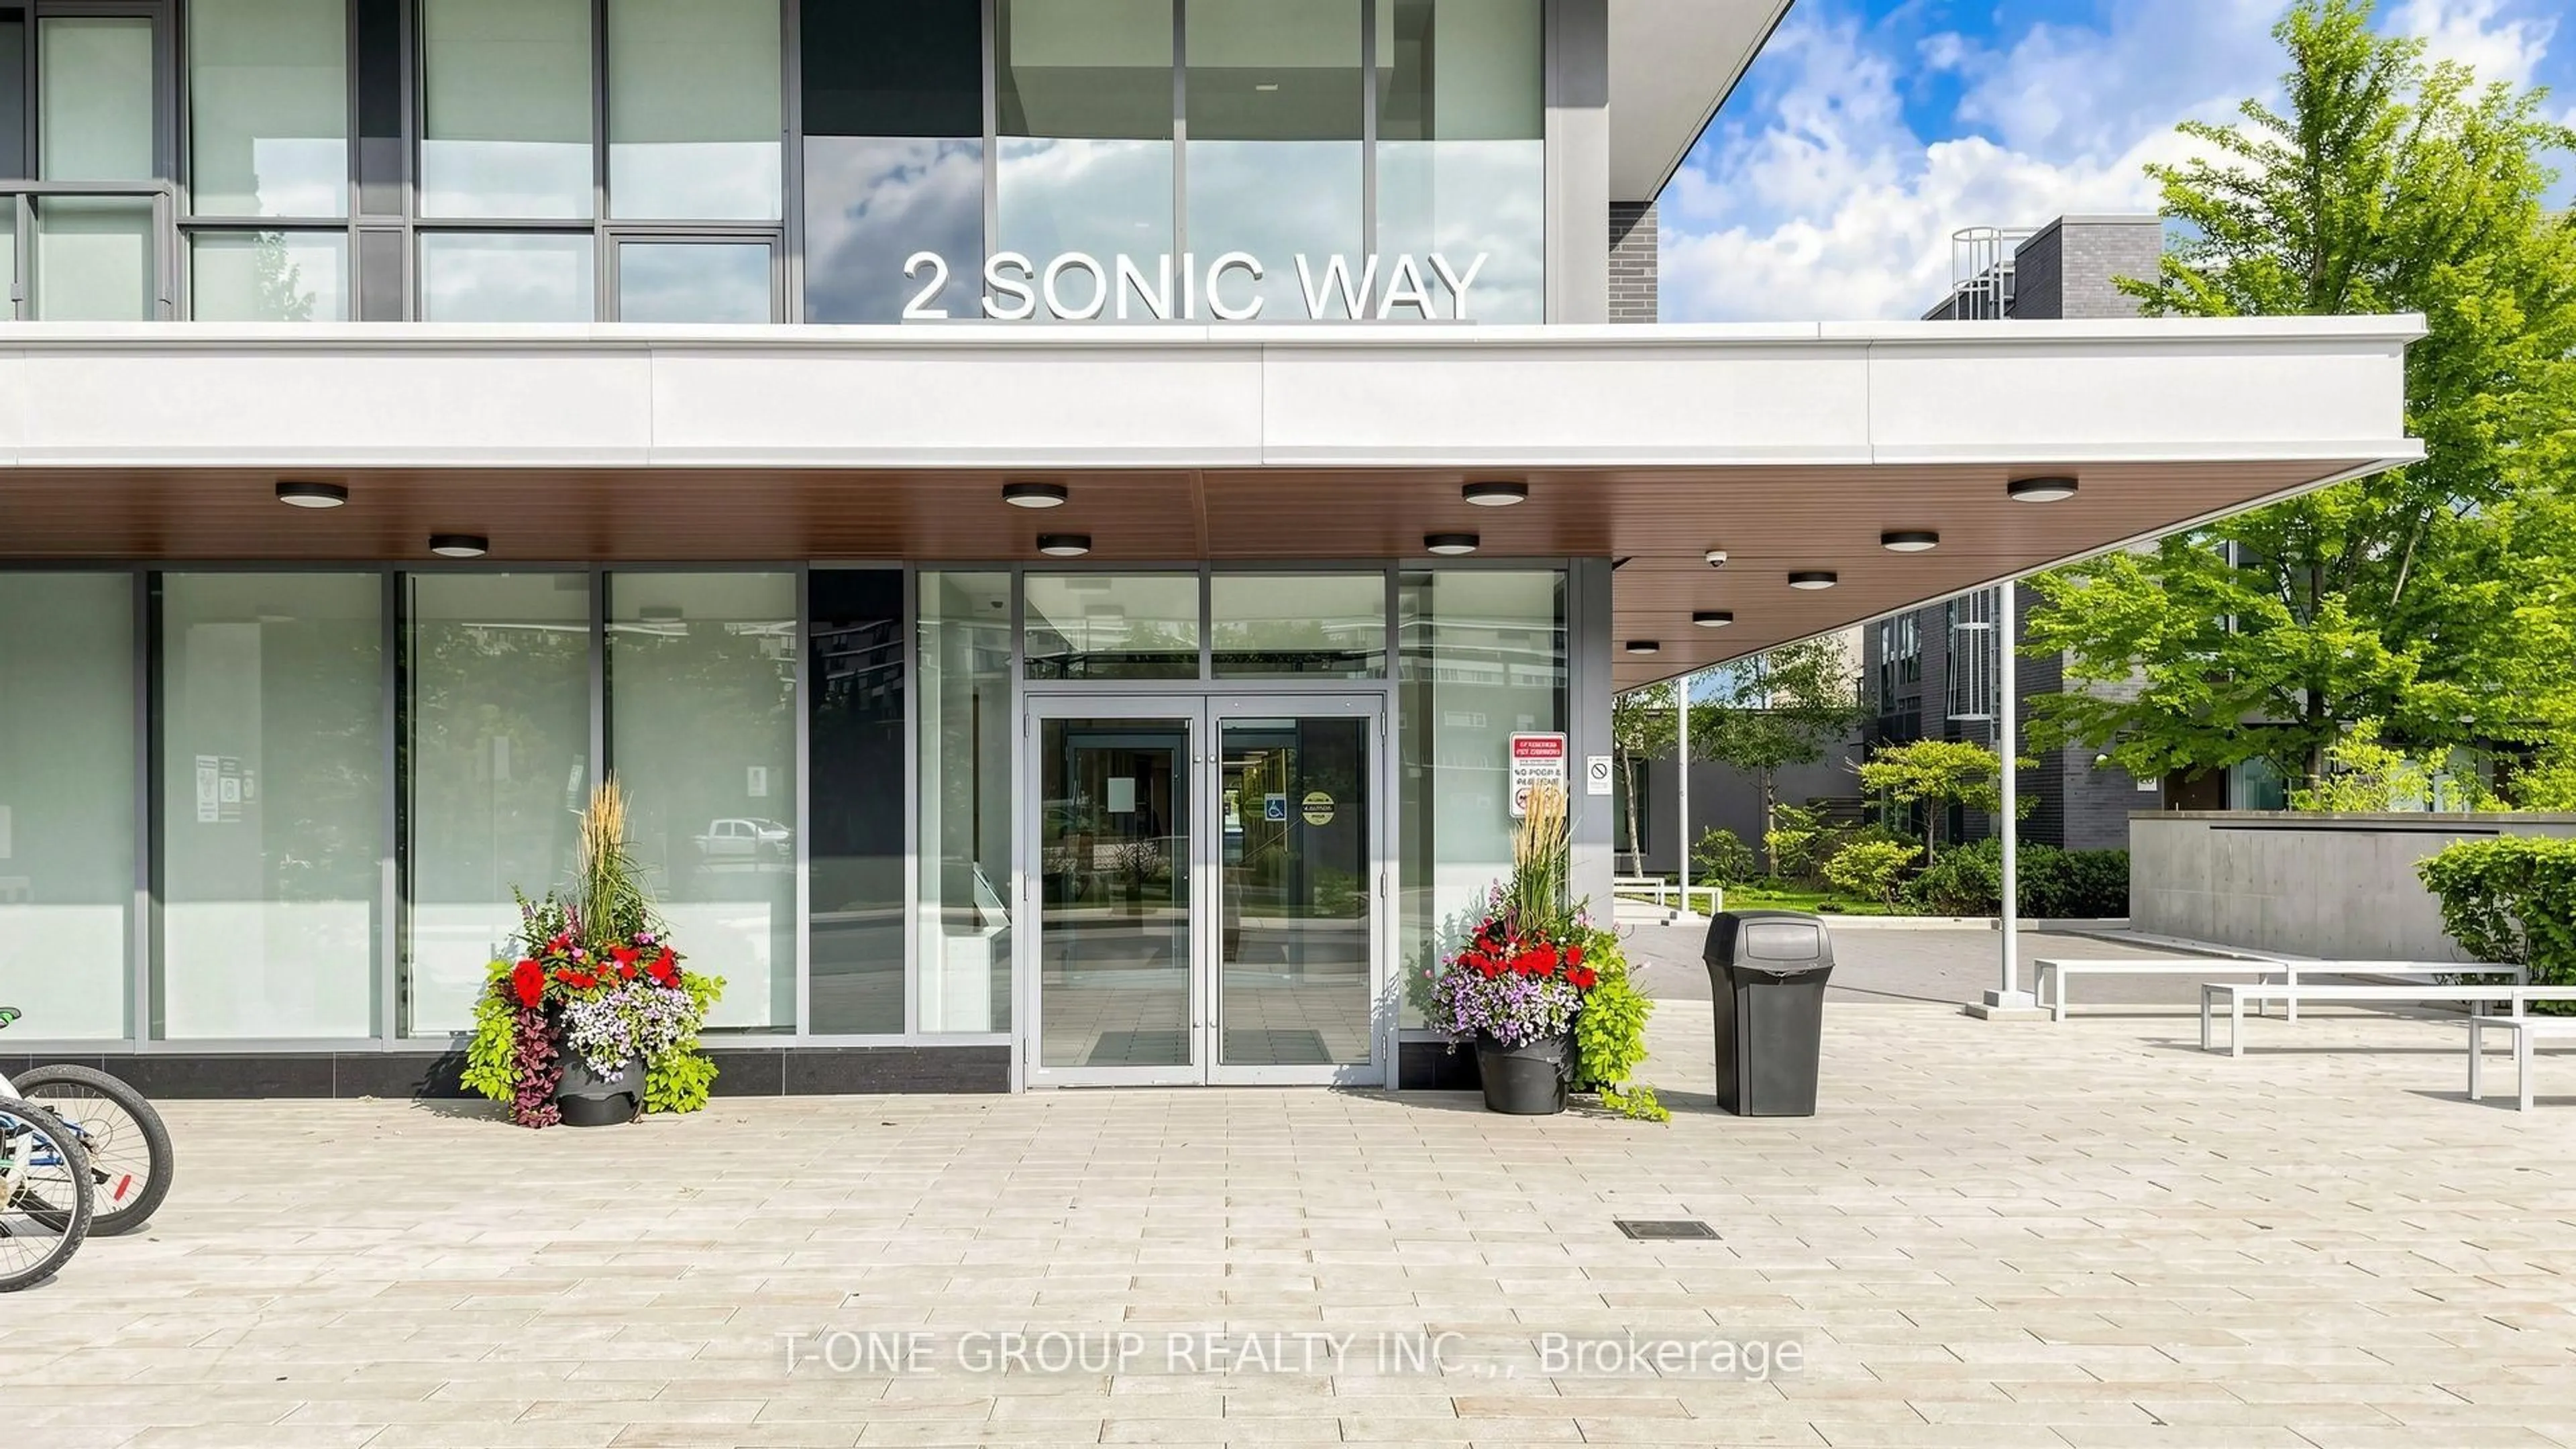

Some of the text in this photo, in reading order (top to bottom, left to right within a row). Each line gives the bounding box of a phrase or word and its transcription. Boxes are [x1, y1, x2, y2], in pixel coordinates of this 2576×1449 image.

[902, 251, 1487, 320] 2 SONIC WAY
